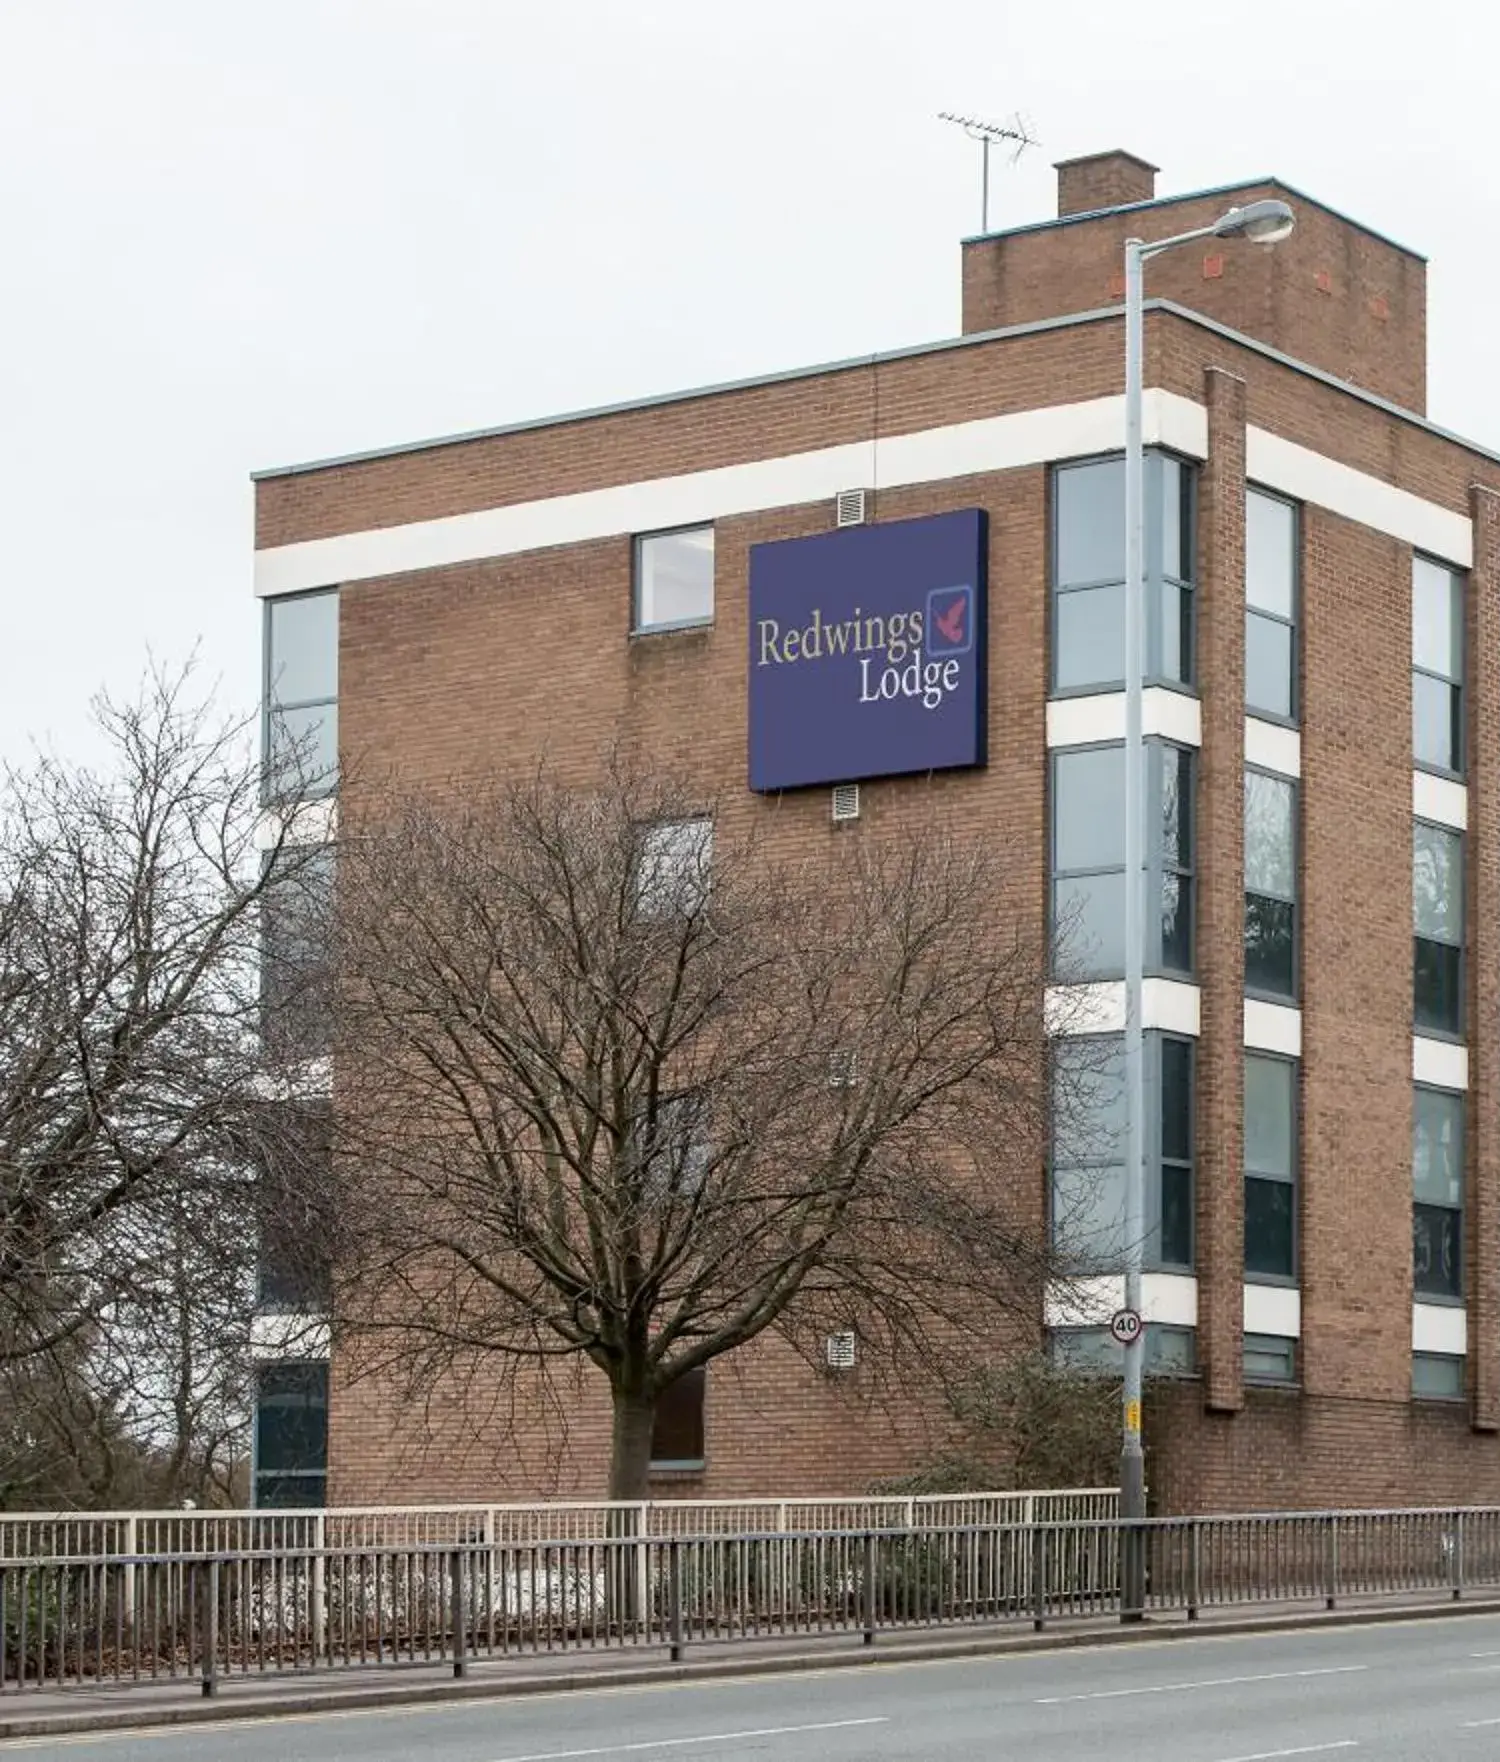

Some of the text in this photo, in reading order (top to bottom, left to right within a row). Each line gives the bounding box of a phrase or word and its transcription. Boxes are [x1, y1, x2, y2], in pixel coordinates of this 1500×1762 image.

[757, 608, 923, 666] Redwings
[860, 648, 960, 709] Lodge
[1116, 1317, 1137, 1332] 40
